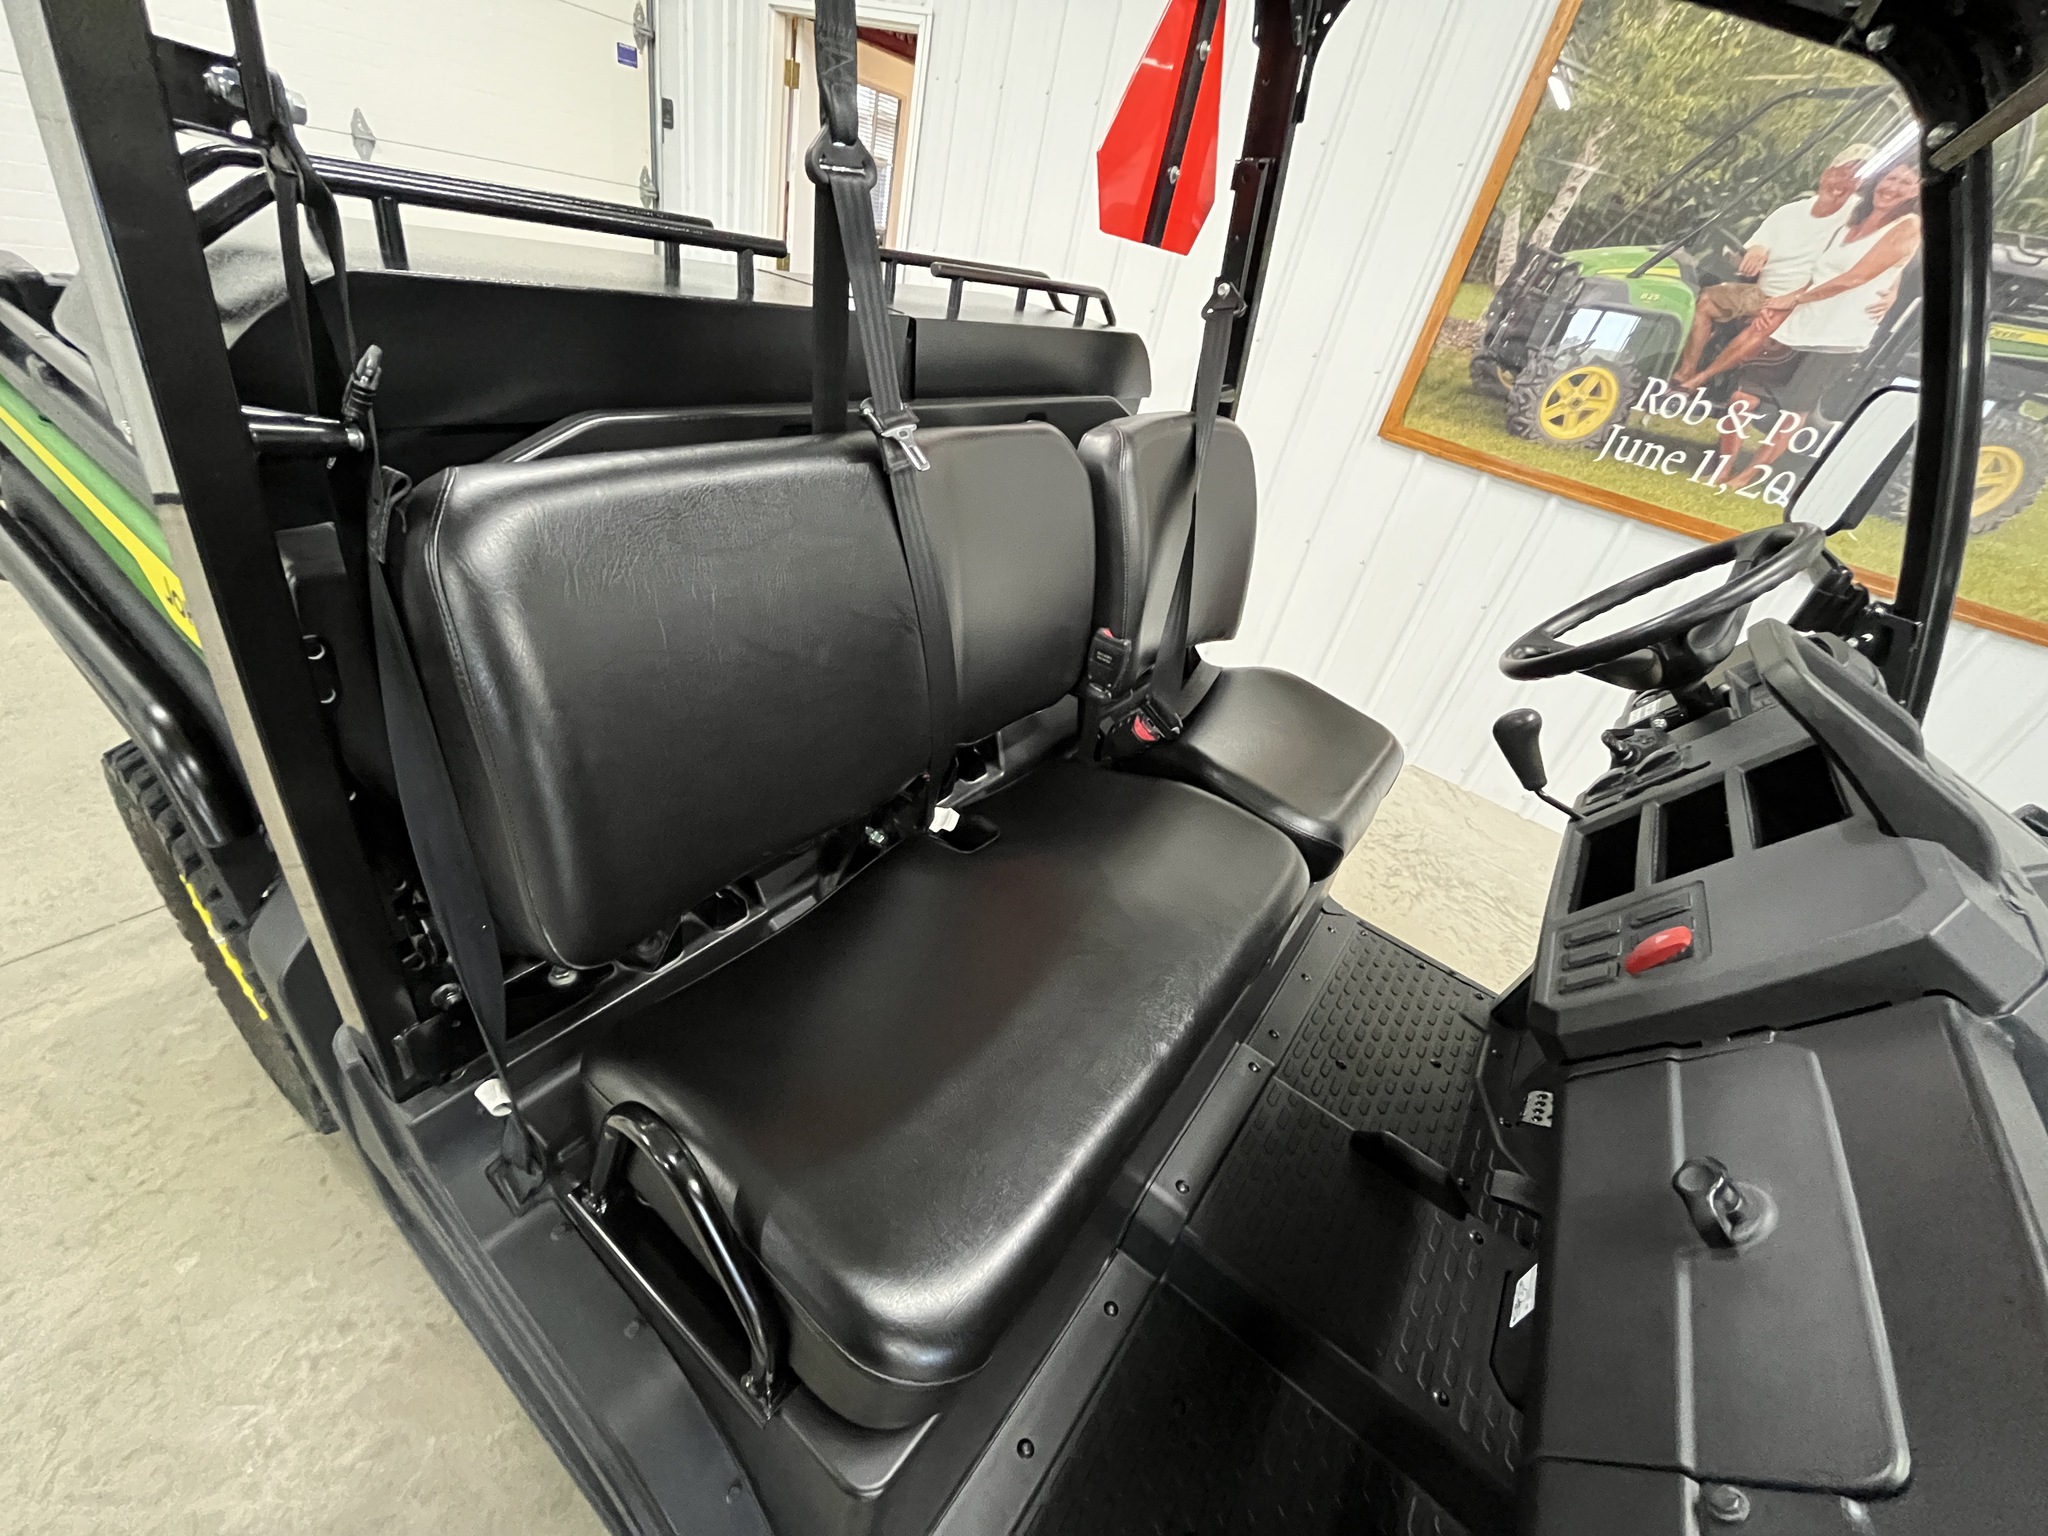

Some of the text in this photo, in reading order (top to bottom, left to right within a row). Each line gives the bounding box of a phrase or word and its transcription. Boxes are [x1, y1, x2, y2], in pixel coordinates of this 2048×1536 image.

[1630, 376, 1843, 459] Rob & Pol
[1593, 424, 1797, 508] June 11, 20
